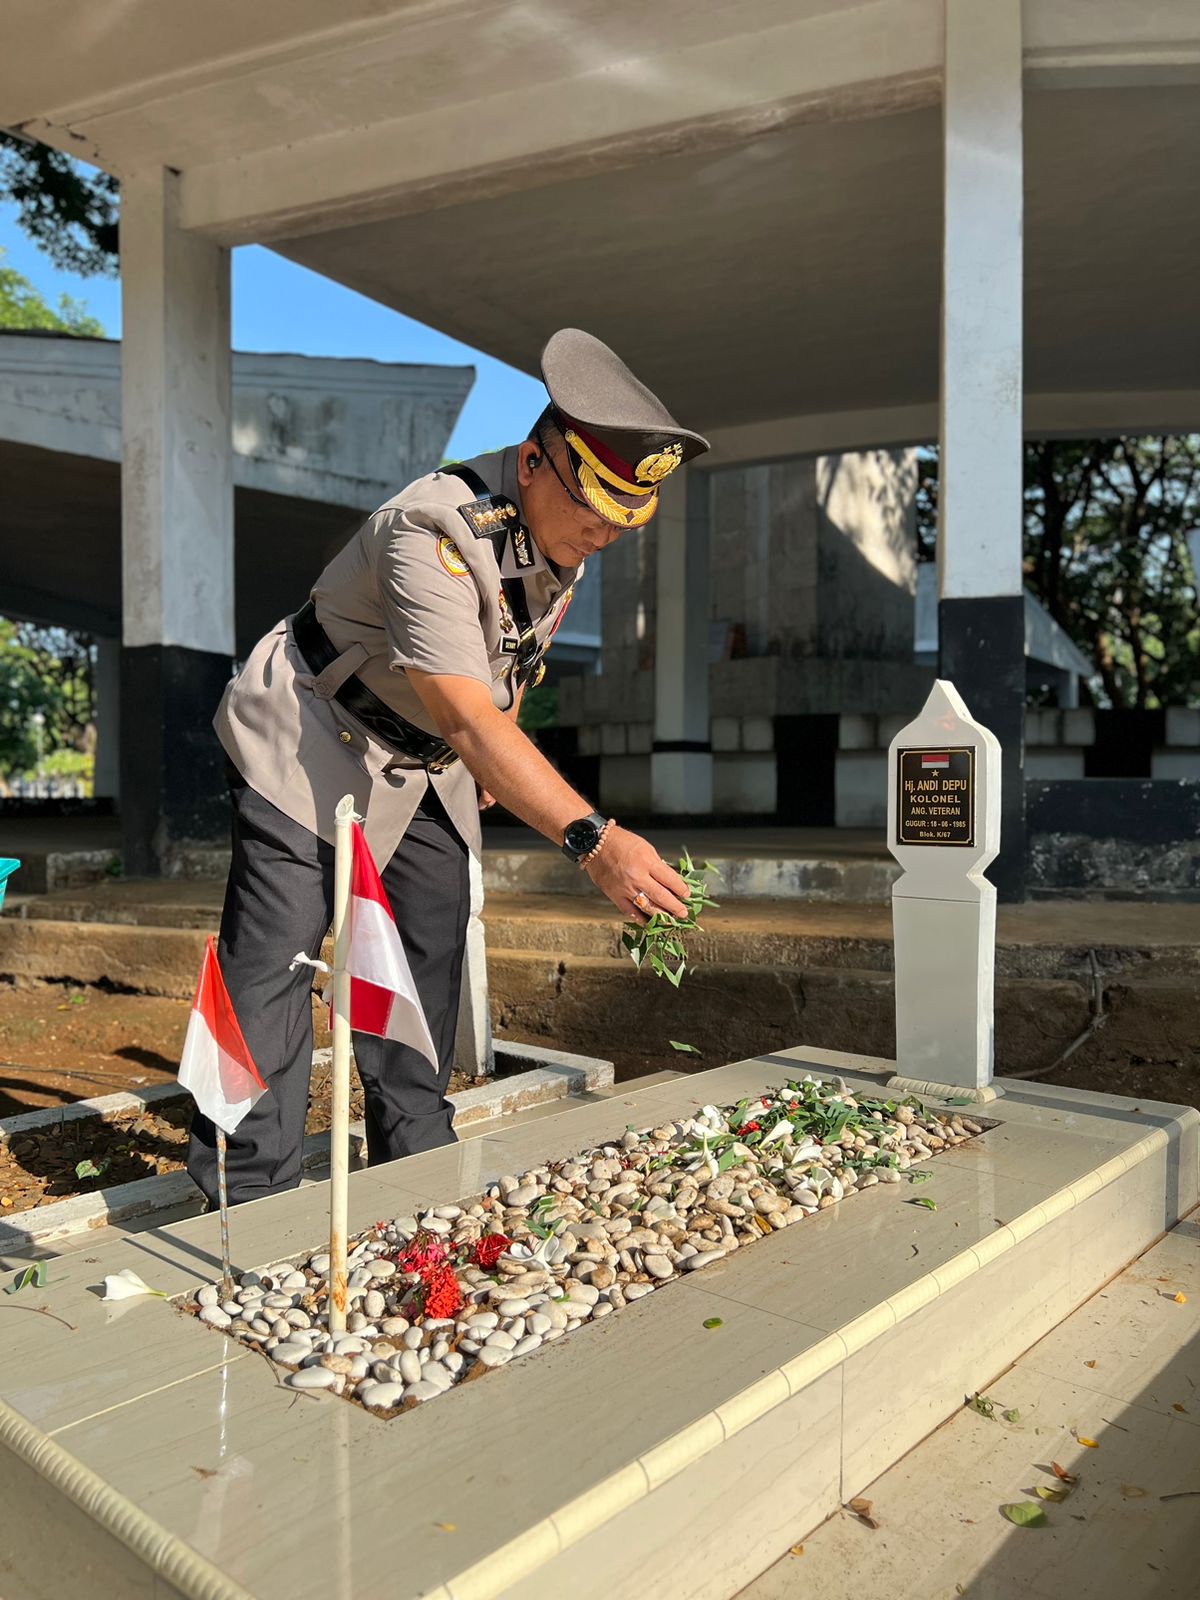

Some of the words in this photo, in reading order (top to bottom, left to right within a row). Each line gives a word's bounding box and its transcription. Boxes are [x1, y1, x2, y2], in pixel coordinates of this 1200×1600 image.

[905, 780, 916, 793] Hj.
[917, 780, 938, 791] ANDI
[942, 780, 967, 791] DEPU
[910, 795, 961, 803] KOLONEL
[911, 807, 928, 815] ANG.
[928, 807, 961, 816] VETERAN
